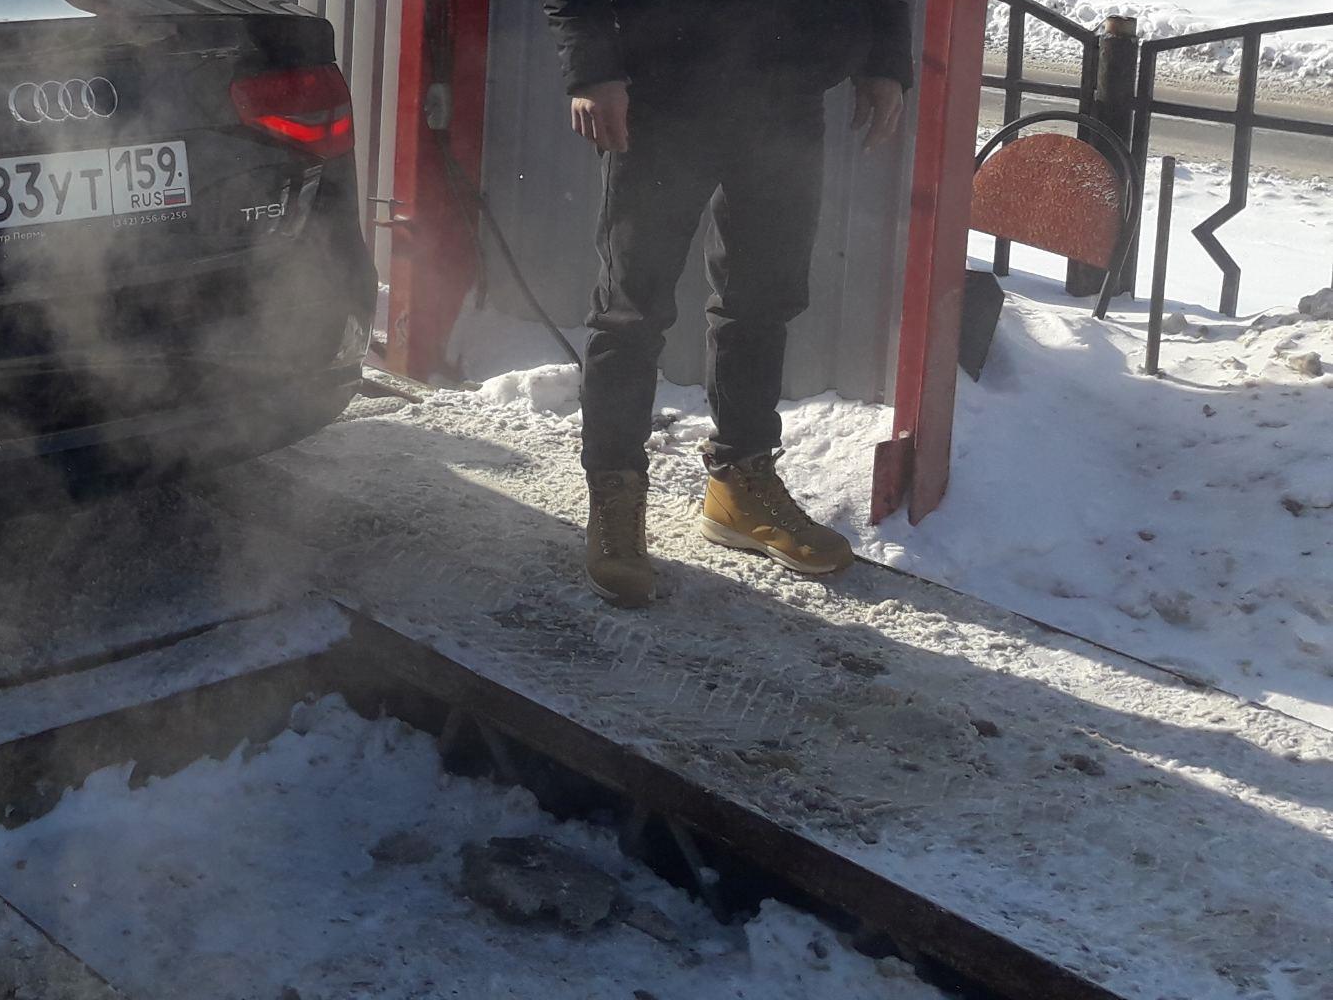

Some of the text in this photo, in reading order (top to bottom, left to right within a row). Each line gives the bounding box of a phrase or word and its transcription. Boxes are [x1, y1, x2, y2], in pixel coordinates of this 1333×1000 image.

[114, 146, 177, 191] 159
[131, 191, 163, 209] RUS
[140, 210, 188, 225] 256-6-256
